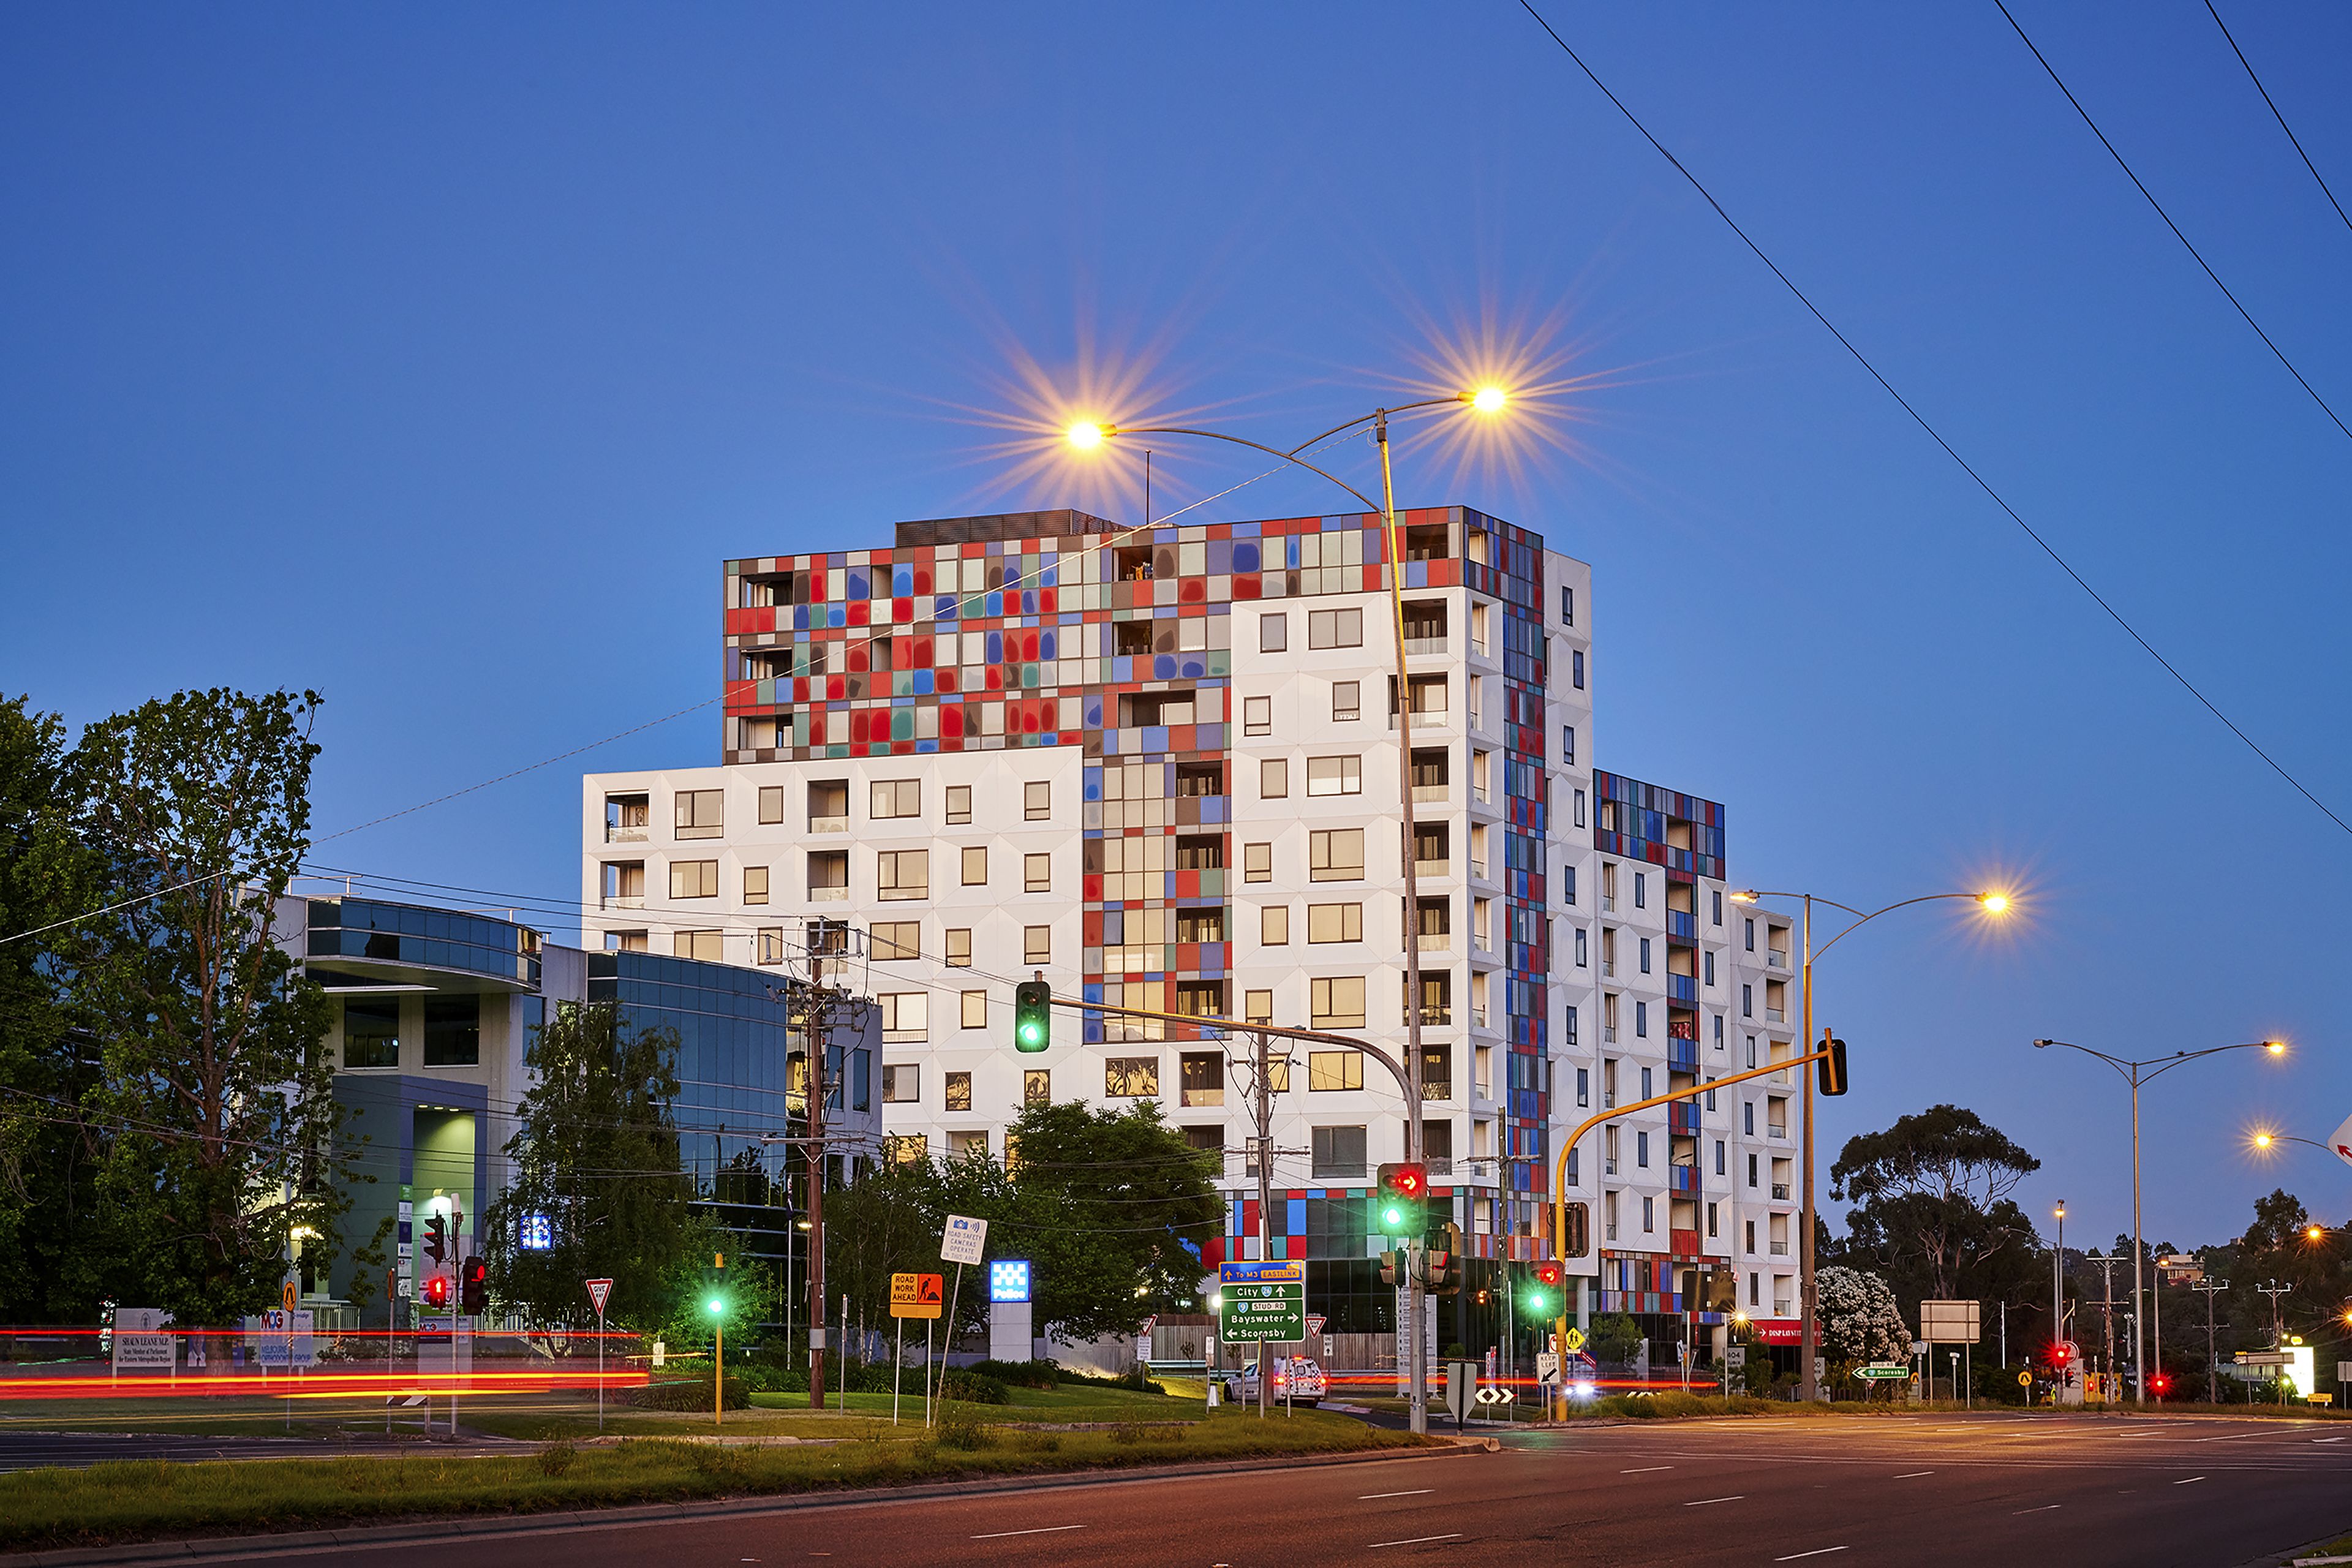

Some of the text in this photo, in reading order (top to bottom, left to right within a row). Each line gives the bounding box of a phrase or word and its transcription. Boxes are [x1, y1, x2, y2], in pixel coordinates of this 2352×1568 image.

[951, 1238, 977, 1248] CAMERAS
[950, 1245, 975, 1255] OPERATE
[993, 1288, 1026, 1299] Police
[1237, 1287, 1258, 1297] City
[261, 1311, 283, 1329] MOG
[1231, 1315, 1284, 1324] Bayswater
[1241, 1329, 1286, 1338] Scoresby
